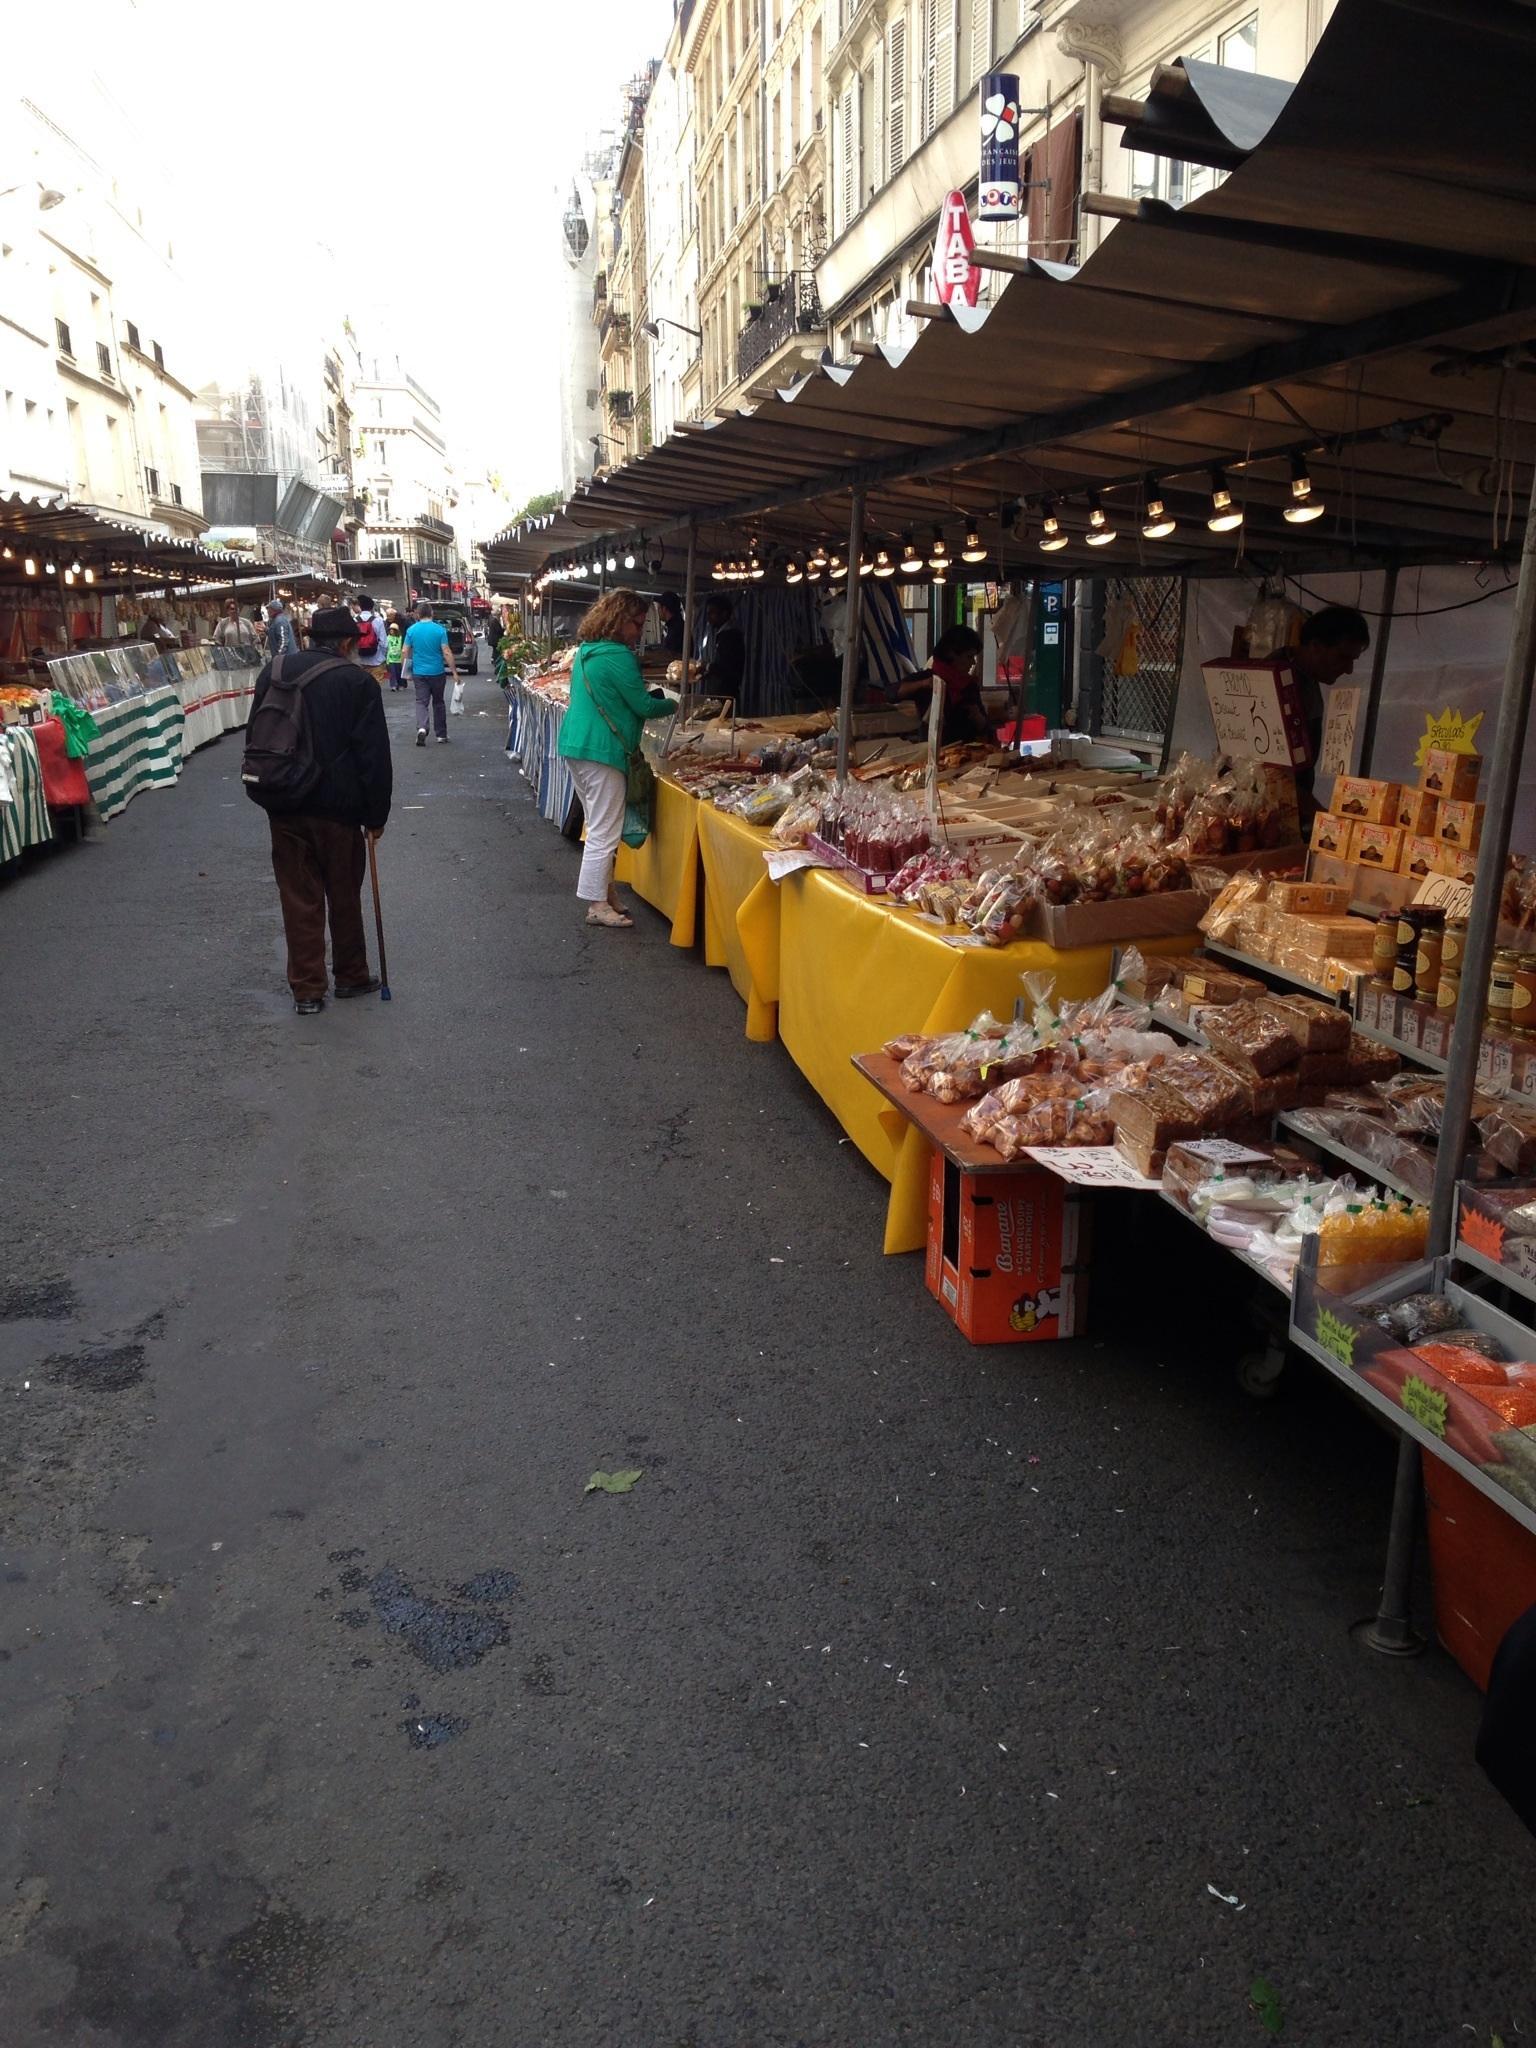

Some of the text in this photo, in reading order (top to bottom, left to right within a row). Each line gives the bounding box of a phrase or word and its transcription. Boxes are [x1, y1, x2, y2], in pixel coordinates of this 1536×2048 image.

[946, 207, 969, 305] TABA
[1250, 700, 1270, 754] 5
[995, 1198, 1015, 1273] Banane
[1025, 1200, 1033, 1265] MARTINIQUE
